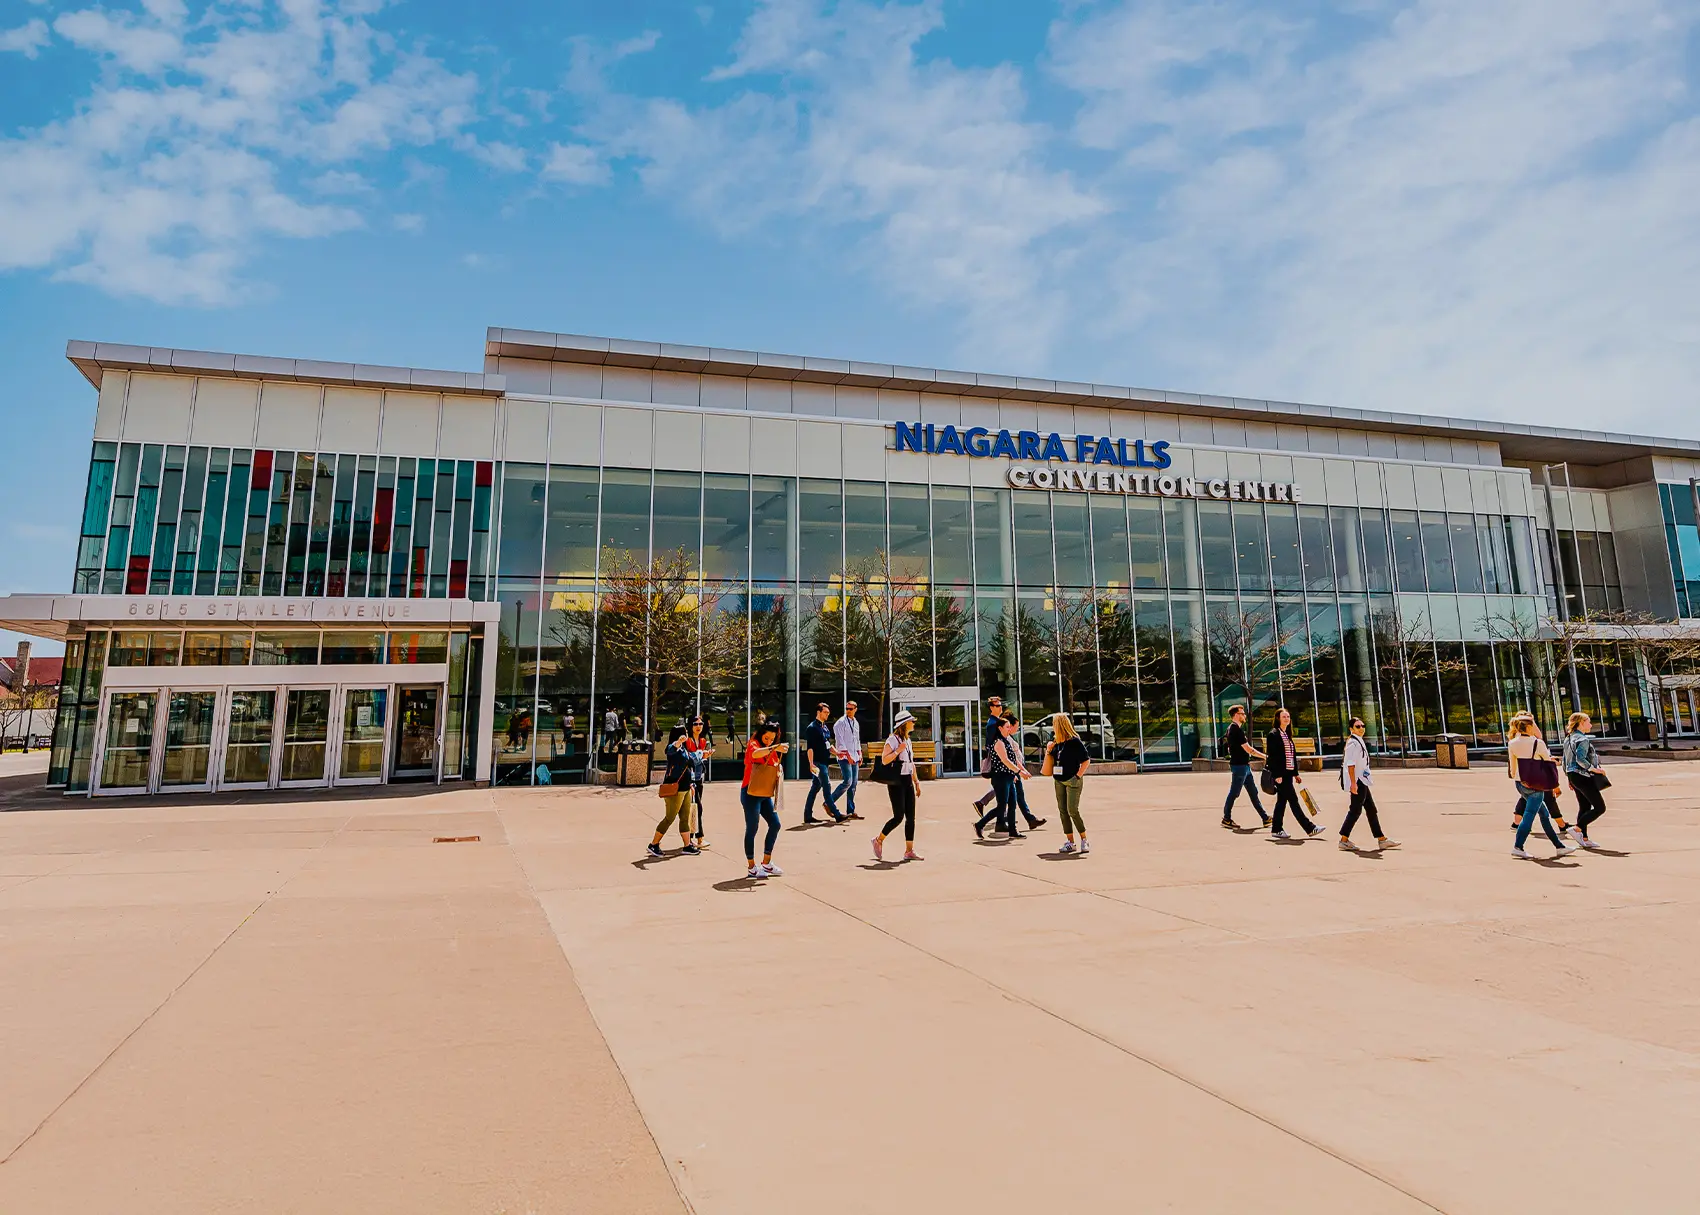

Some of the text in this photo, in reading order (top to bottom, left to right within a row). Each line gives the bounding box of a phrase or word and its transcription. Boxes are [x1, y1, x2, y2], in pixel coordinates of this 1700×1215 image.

[895, 420, 1172, 469] NIAGARA FALLS
[1006, 465, 1302, 502] CONVENTION CENTRE
[128, 602, 411, 618] 6815 STANLEY AVENUE
